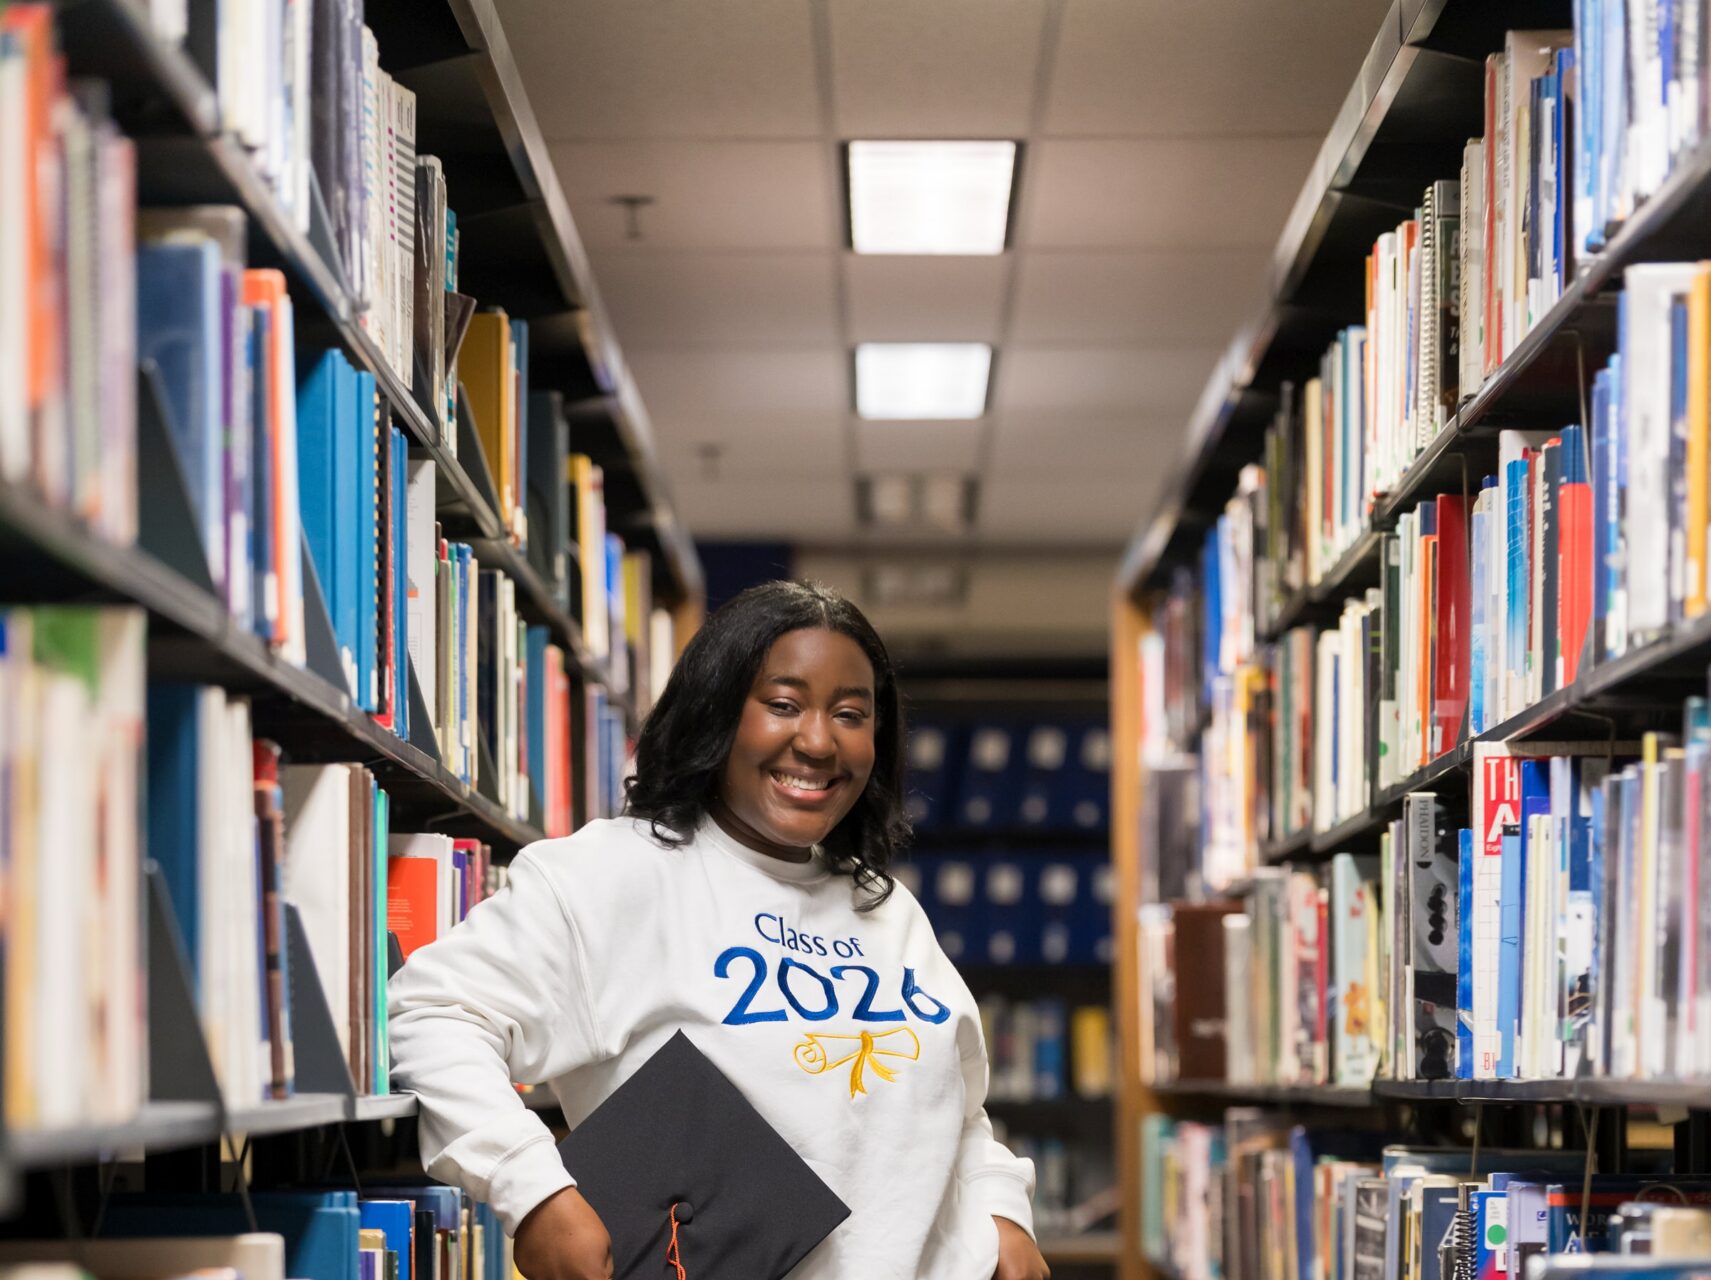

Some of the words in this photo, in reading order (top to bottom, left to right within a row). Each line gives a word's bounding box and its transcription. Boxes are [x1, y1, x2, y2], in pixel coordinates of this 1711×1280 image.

[1418, 800, 1431, 859] PHAIDON
[755, 912, 827, 957] Class
[833, 937, 864, 958] of
[713, 946, 951, 1025] 2026
